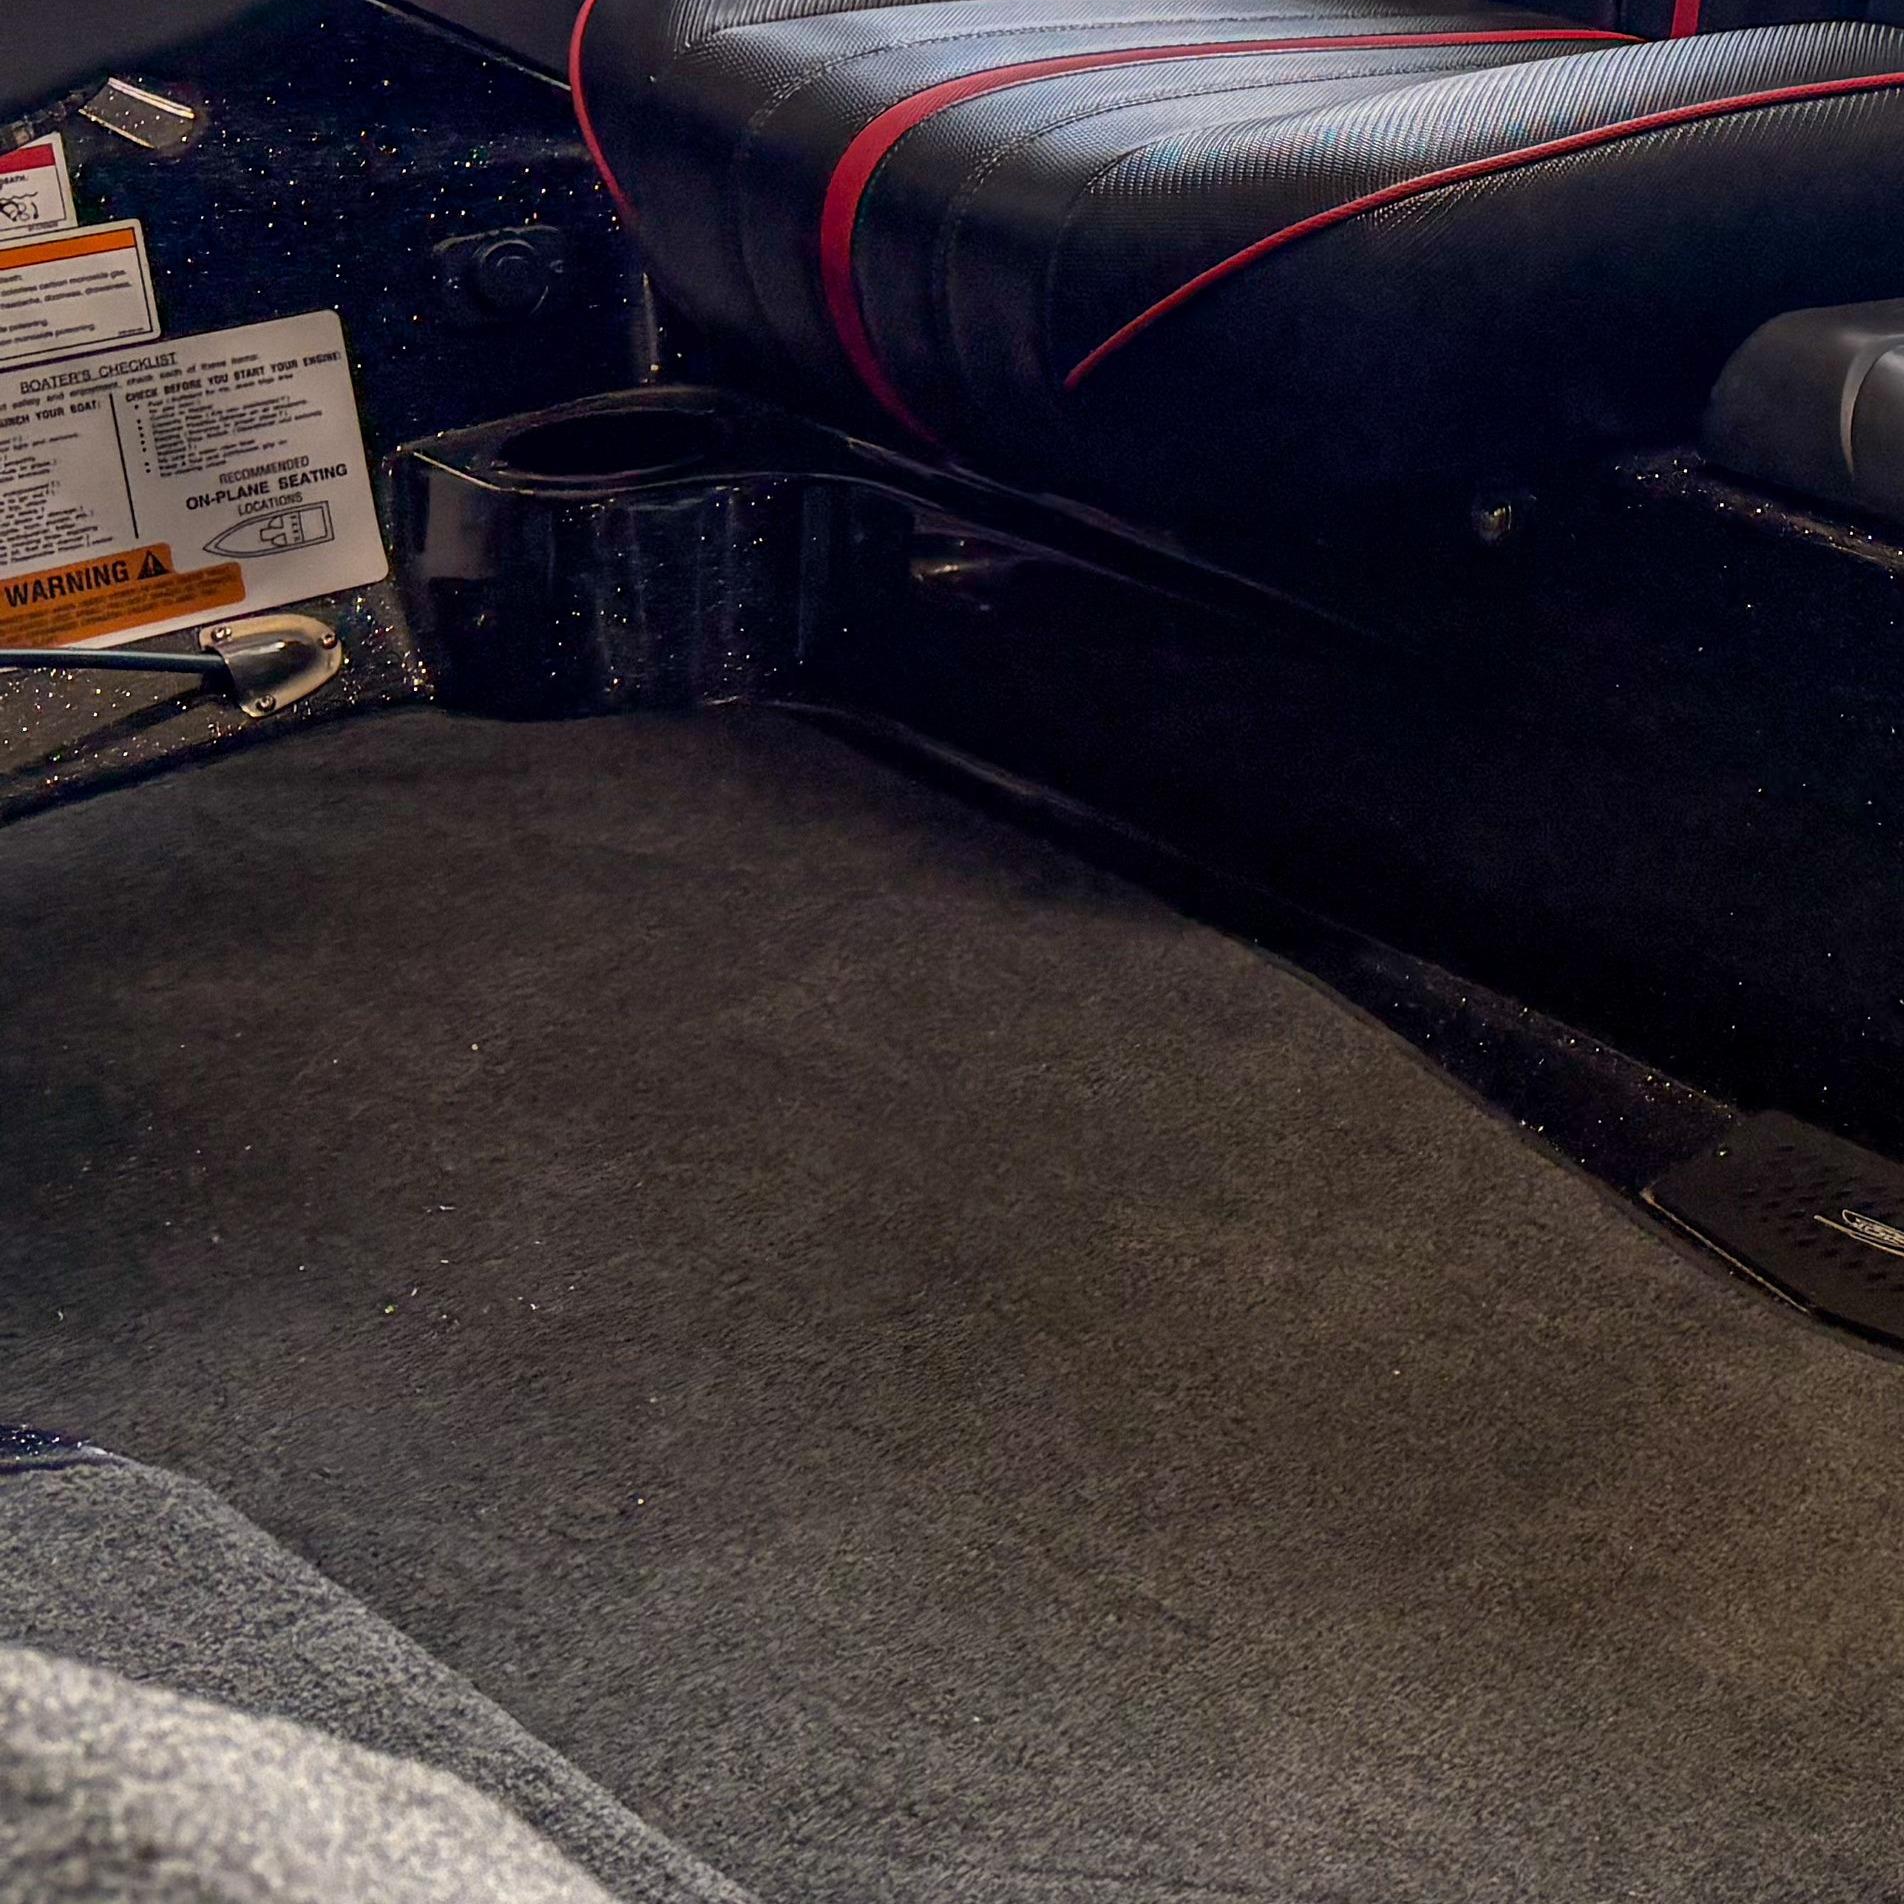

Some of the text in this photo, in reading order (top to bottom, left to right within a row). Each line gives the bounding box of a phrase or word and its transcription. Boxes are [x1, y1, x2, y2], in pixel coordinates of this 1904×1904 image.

[98, 352, 177, 380] CHECKLIST
[219, 455, 310, 484] RECOMMENDED
[185, 463, 348, 510] ON-PLANE SEATING
[238, 491, 303, 516] LOCATIONS
[4, 560, 130, 608] WARNING
